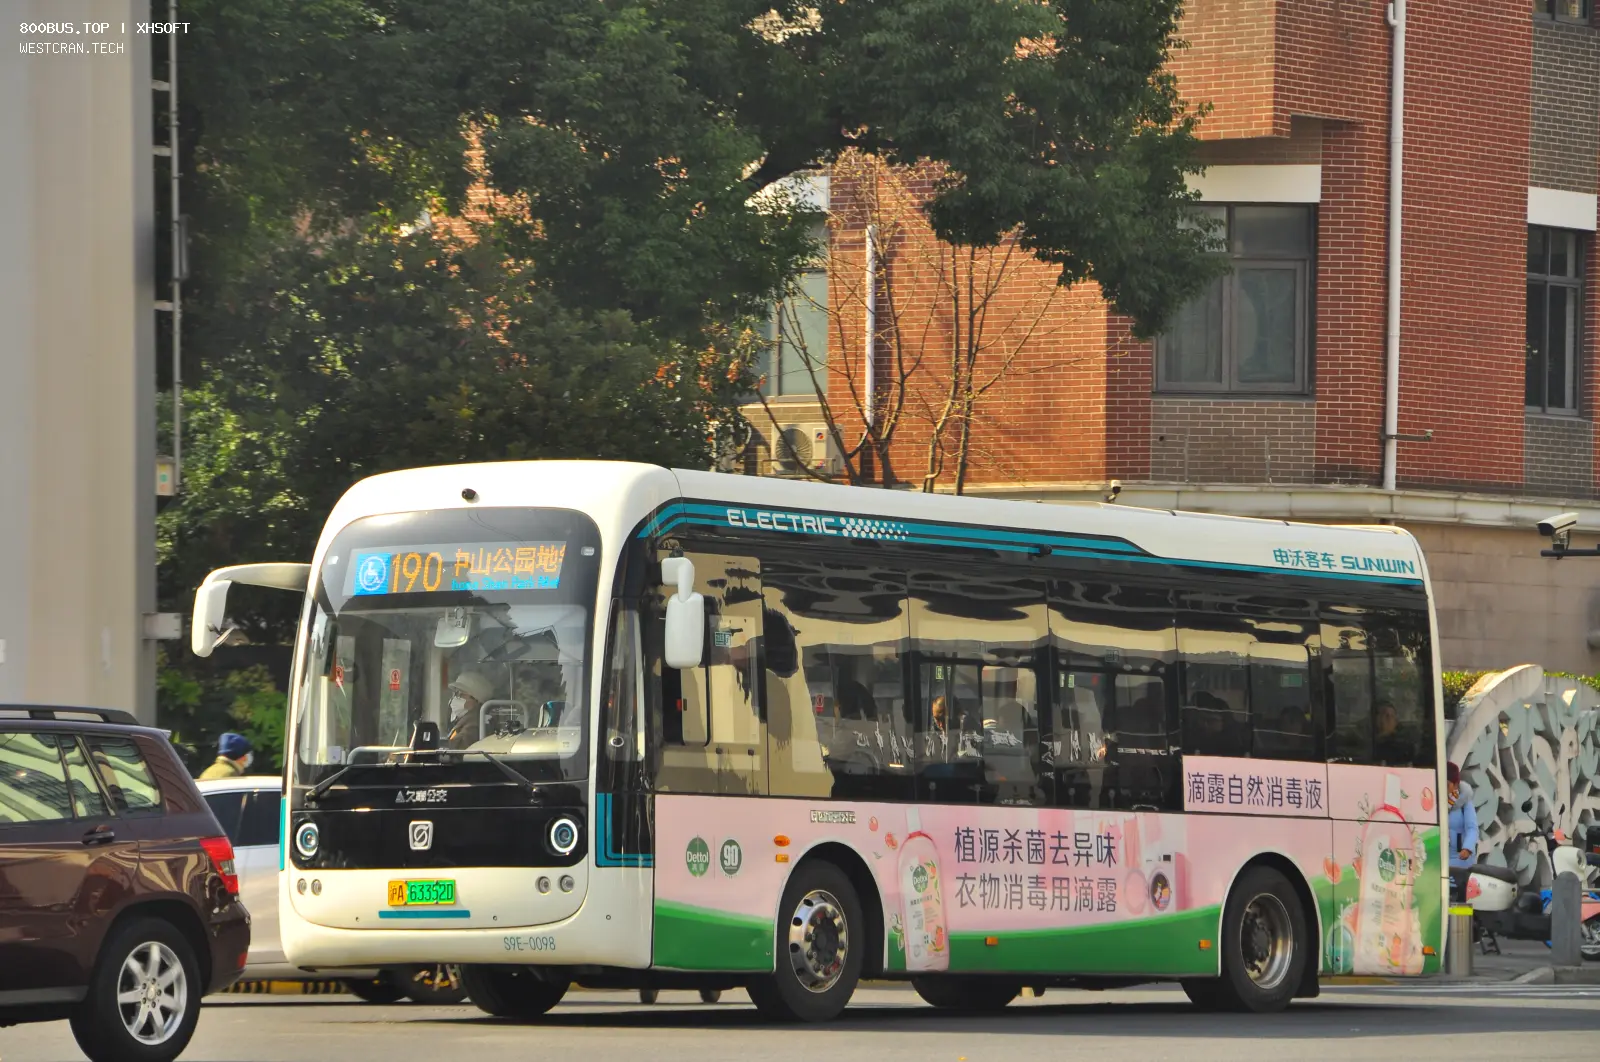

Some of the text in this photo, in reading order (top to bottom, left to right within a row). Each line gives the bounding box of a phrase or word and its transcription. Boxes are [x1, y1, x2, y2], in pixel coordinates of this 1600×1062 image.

[726, 508, 837, 535] ELECTRIC
[391, 551, 444, 593] 190
[1272, 548, 1416, 575] 申沃客车 SUNWIN
[1187, 771, 1323, 810] 滴露自然消毒液
[687, 851, 709, 864] Dettol
[723, 845, 739, 867] 90
[954, 826, 1117, 868] 植源杀菌去异味
[954, 872, 1117, 912] 衣物消毒用滴露
[503, 936, 556, 951] S9E-0098
